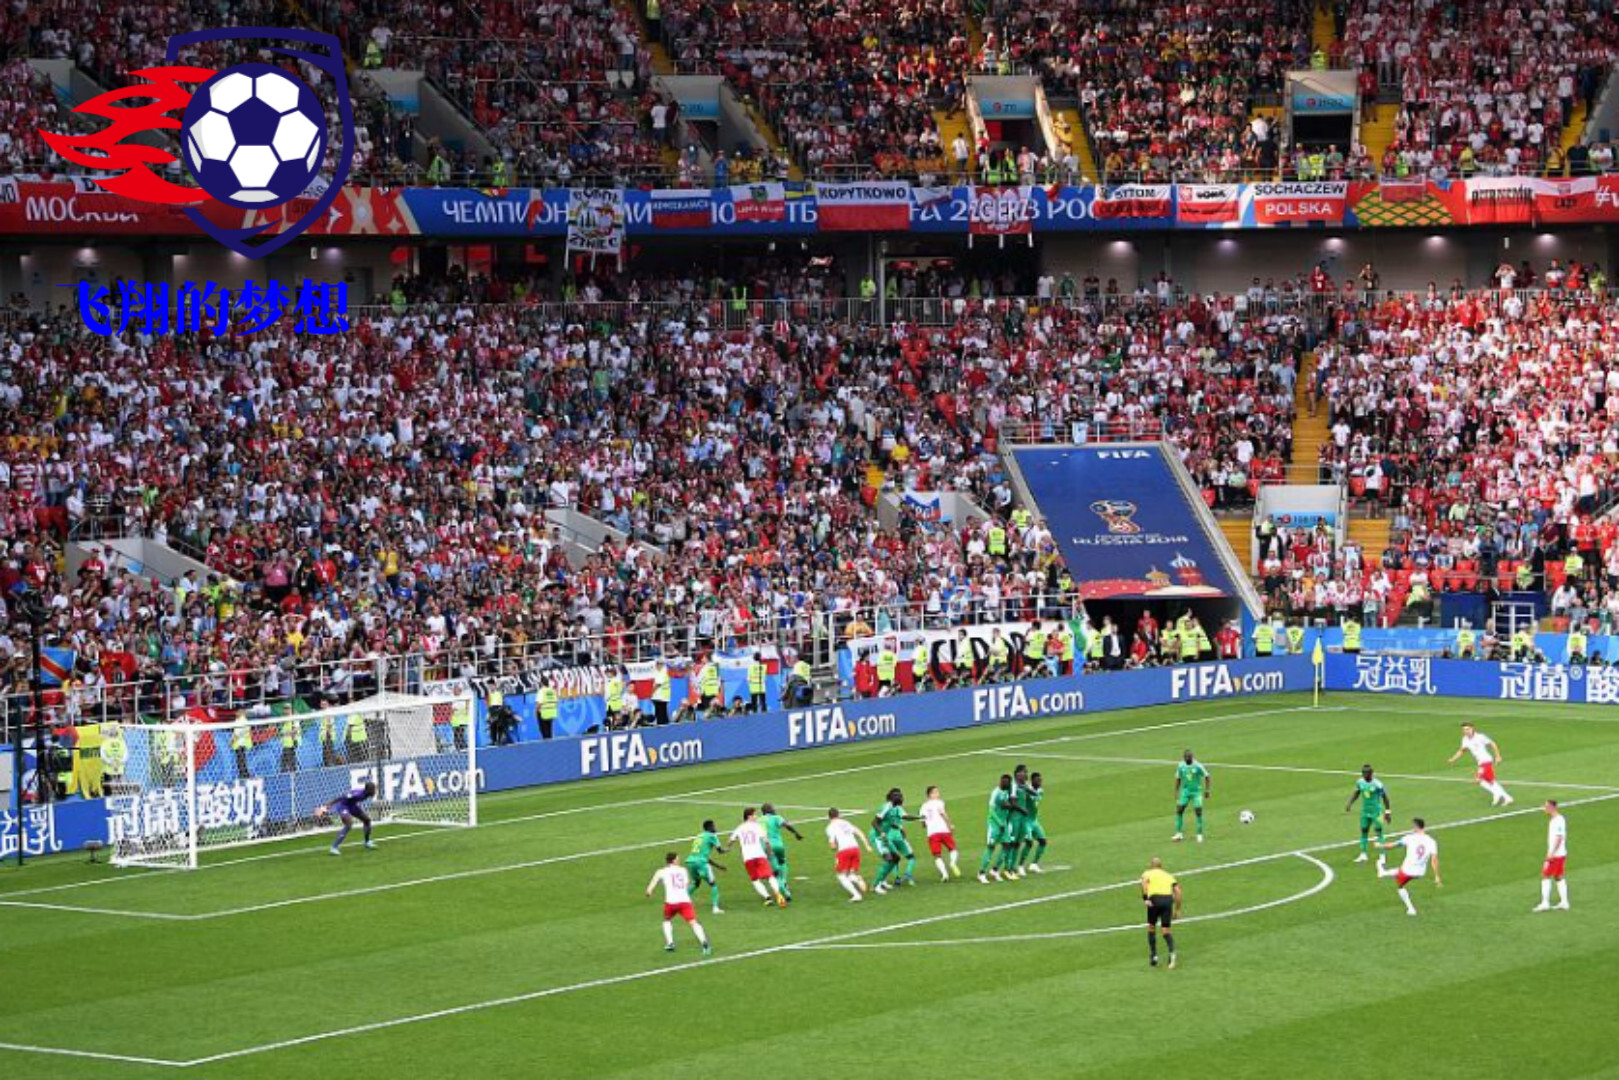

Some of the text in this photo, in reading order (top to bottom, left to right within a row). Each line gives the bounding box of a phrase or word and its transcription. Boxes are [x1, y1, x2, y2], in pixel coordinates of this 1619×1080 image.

[818, 185, 907, 199] KOPYTKOWO
[1255, 183, 1345, 196] SOCHACZEW
[969, 199, 1032, 222] ZGIERZ
[1265, 201, 1332, 216] POLSKA
[1097, 449, 1152, 459] FIFA
[1072, 533, 1143, 546] RUSSIA
[1352, 655, 1437, 694] 冠益乳
[1415, 843, 1427, 861] 9
